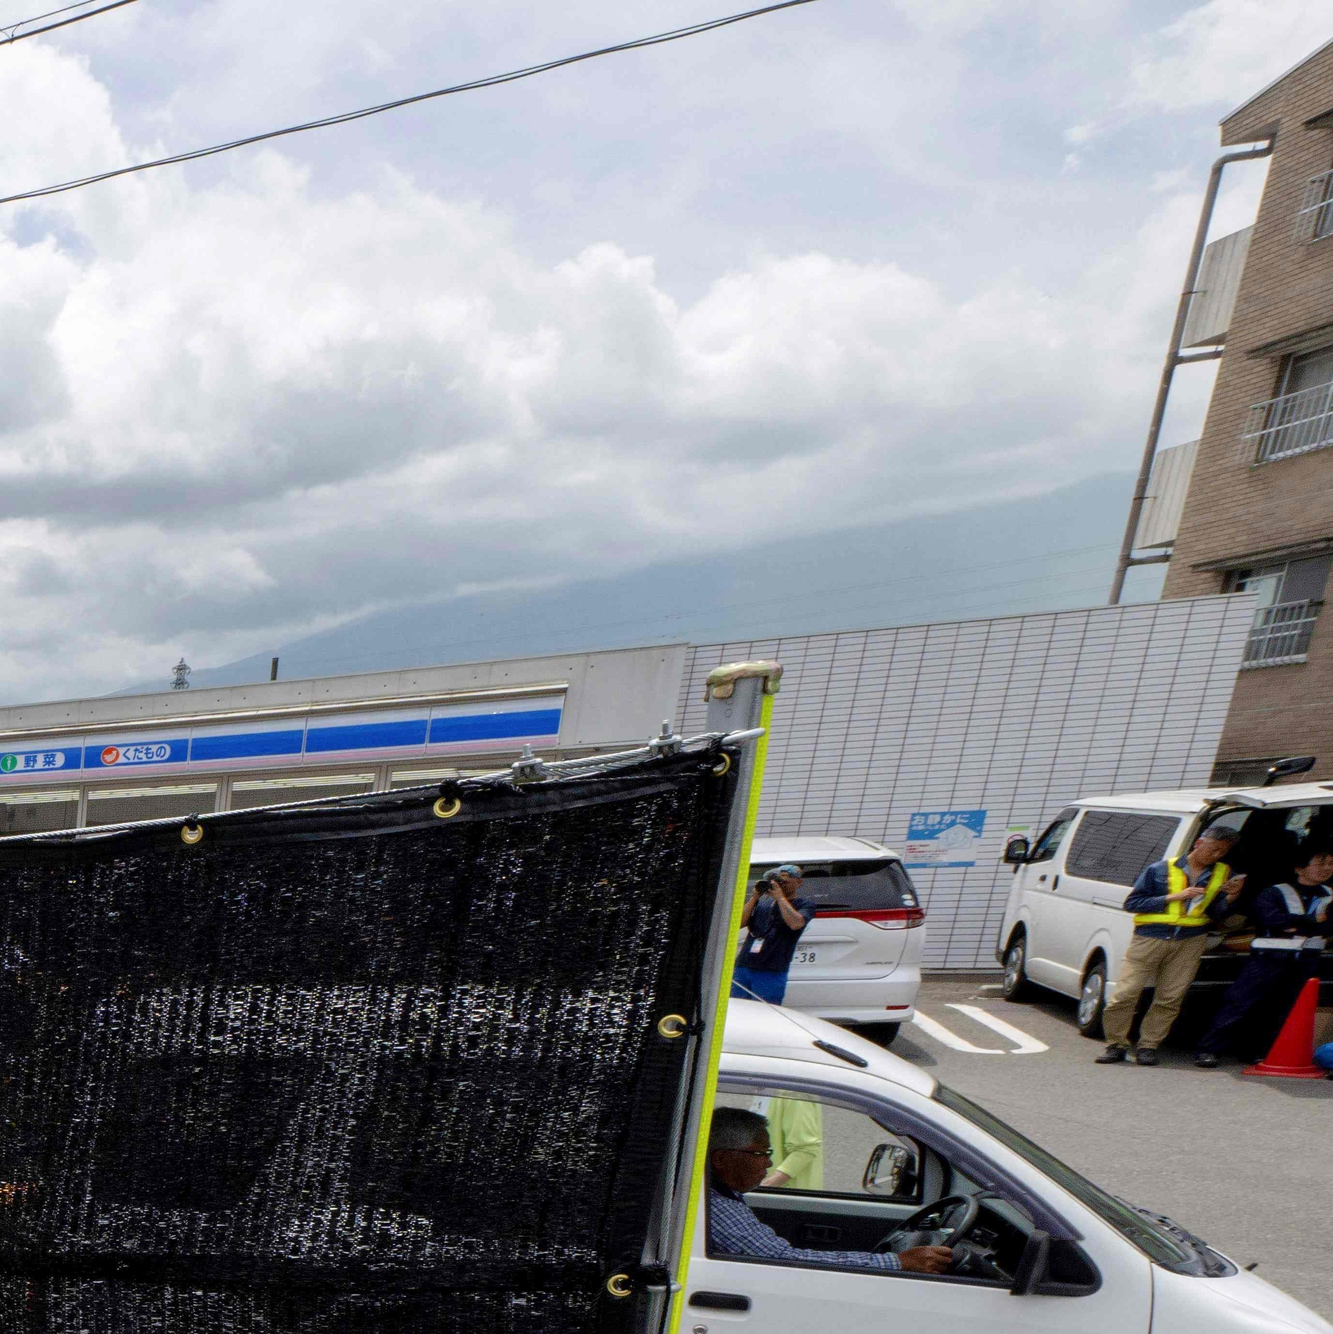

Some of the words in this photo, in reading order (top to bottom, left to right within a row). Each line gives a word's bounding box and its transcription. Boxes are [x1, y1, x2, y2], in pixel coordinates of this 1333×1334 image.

[23, 752, 57, 768] 野菜
[122, 745, 167, 761] くだもの
[794, 952, 816, 963] -38
